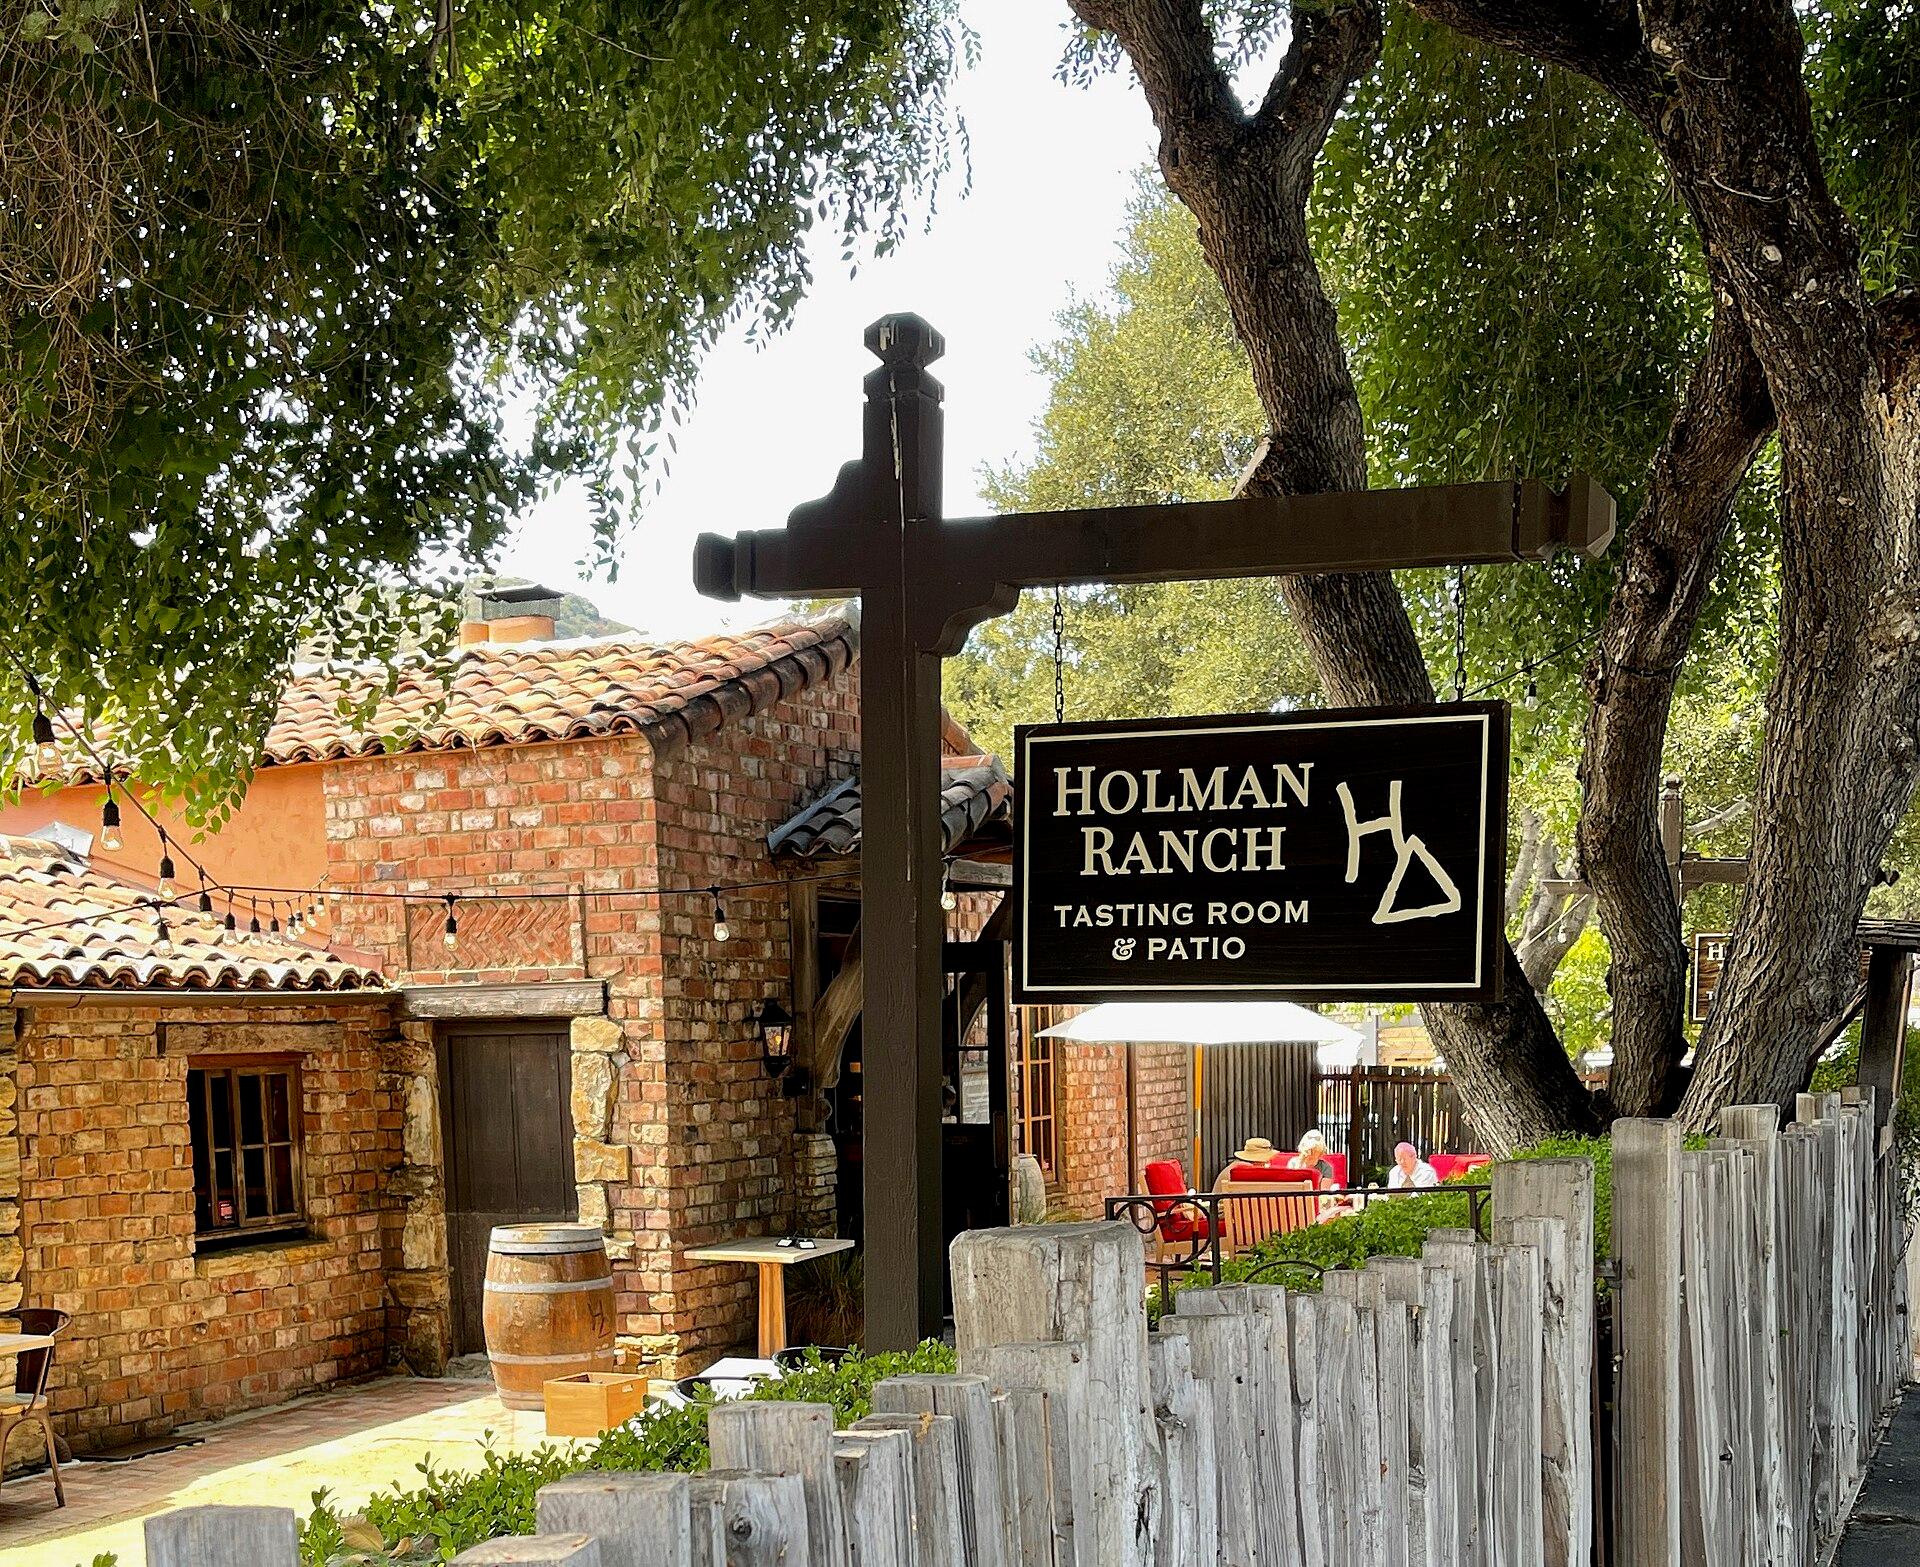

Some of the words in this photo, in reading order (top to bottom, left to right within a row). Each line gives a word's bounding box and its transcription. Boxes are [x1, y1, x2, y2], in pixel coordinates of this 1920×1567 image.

[1053, 762, 1315, 817] HOLMAN
[1079, 826, 1287, 876] RANCH
[1053, 902, 1194, 928] TASTING
[1207, 900, 1309, 925] ROOM
[1111, 937, 1137, 961] &
[1147, 936, 1246, 961] PATIO
